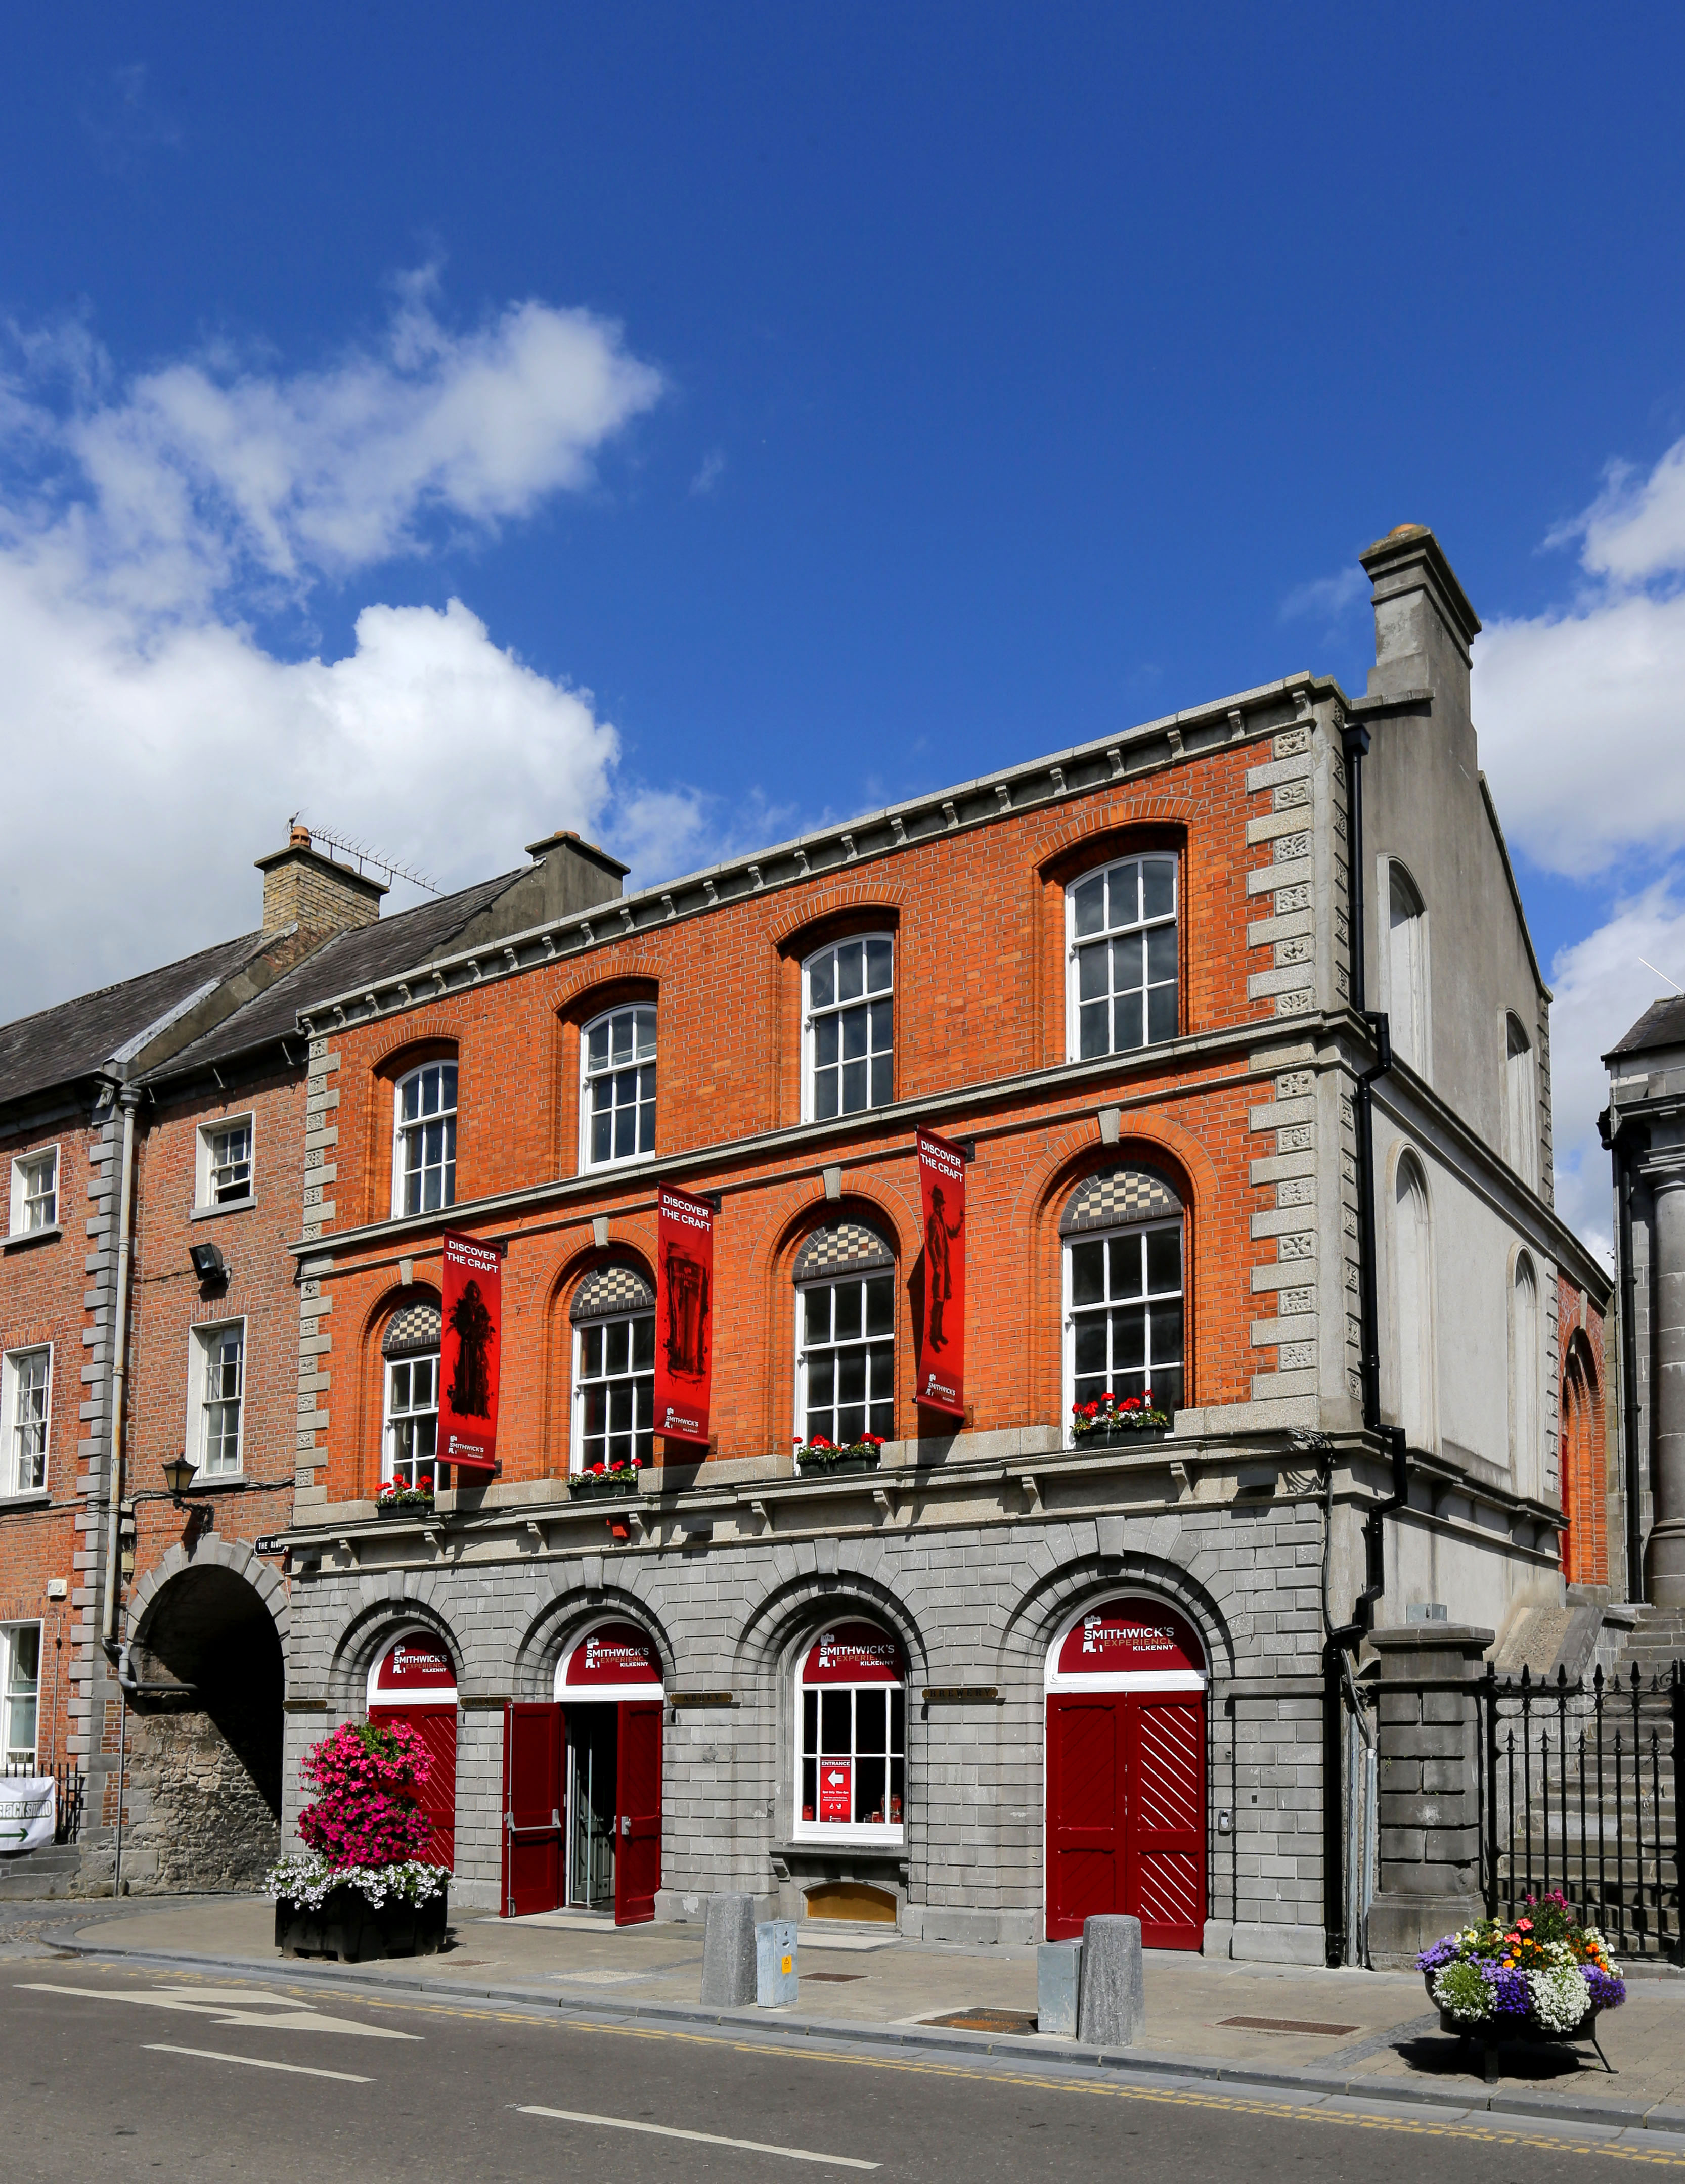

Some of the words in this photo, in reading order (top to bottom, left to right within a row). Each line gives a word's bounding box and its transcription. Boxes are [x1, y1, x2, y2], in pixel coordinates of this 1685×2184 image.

[921, 1140, 961, 1168] DISCOVER
[920, 1153, 937, 1169] THE
[938, 1163, 963, 1182] CRAFT
[663, 1194, 709, 1218] DISCOVER
[661, 1207, 680, 1221] THE
[681, 1215, 711, 1232] CRAFT
[449, 1240, 496, 1261] DISCOVER
[446, 1252, 466, 1265] THE
[467, 1258, 499, 1273] CRAFT
[666, 1415, 699, 1427] SMITHWICK'S
[449, 1442, 484, 1452] SMITHWICK'S
[1084, 1627, 1174, 1640] SMITHWICK'S
[1104, 1637, 1174, 1647] EXPERIENCE
[586, 1647, 649, 1658] SMITHWICK'S
[820, 1645, 895, 1656] SMITHWICK'S
[394, 1655, 447, 1663] SMITHWICK'S
[930, 1689, 991, 1697] BREWERY
